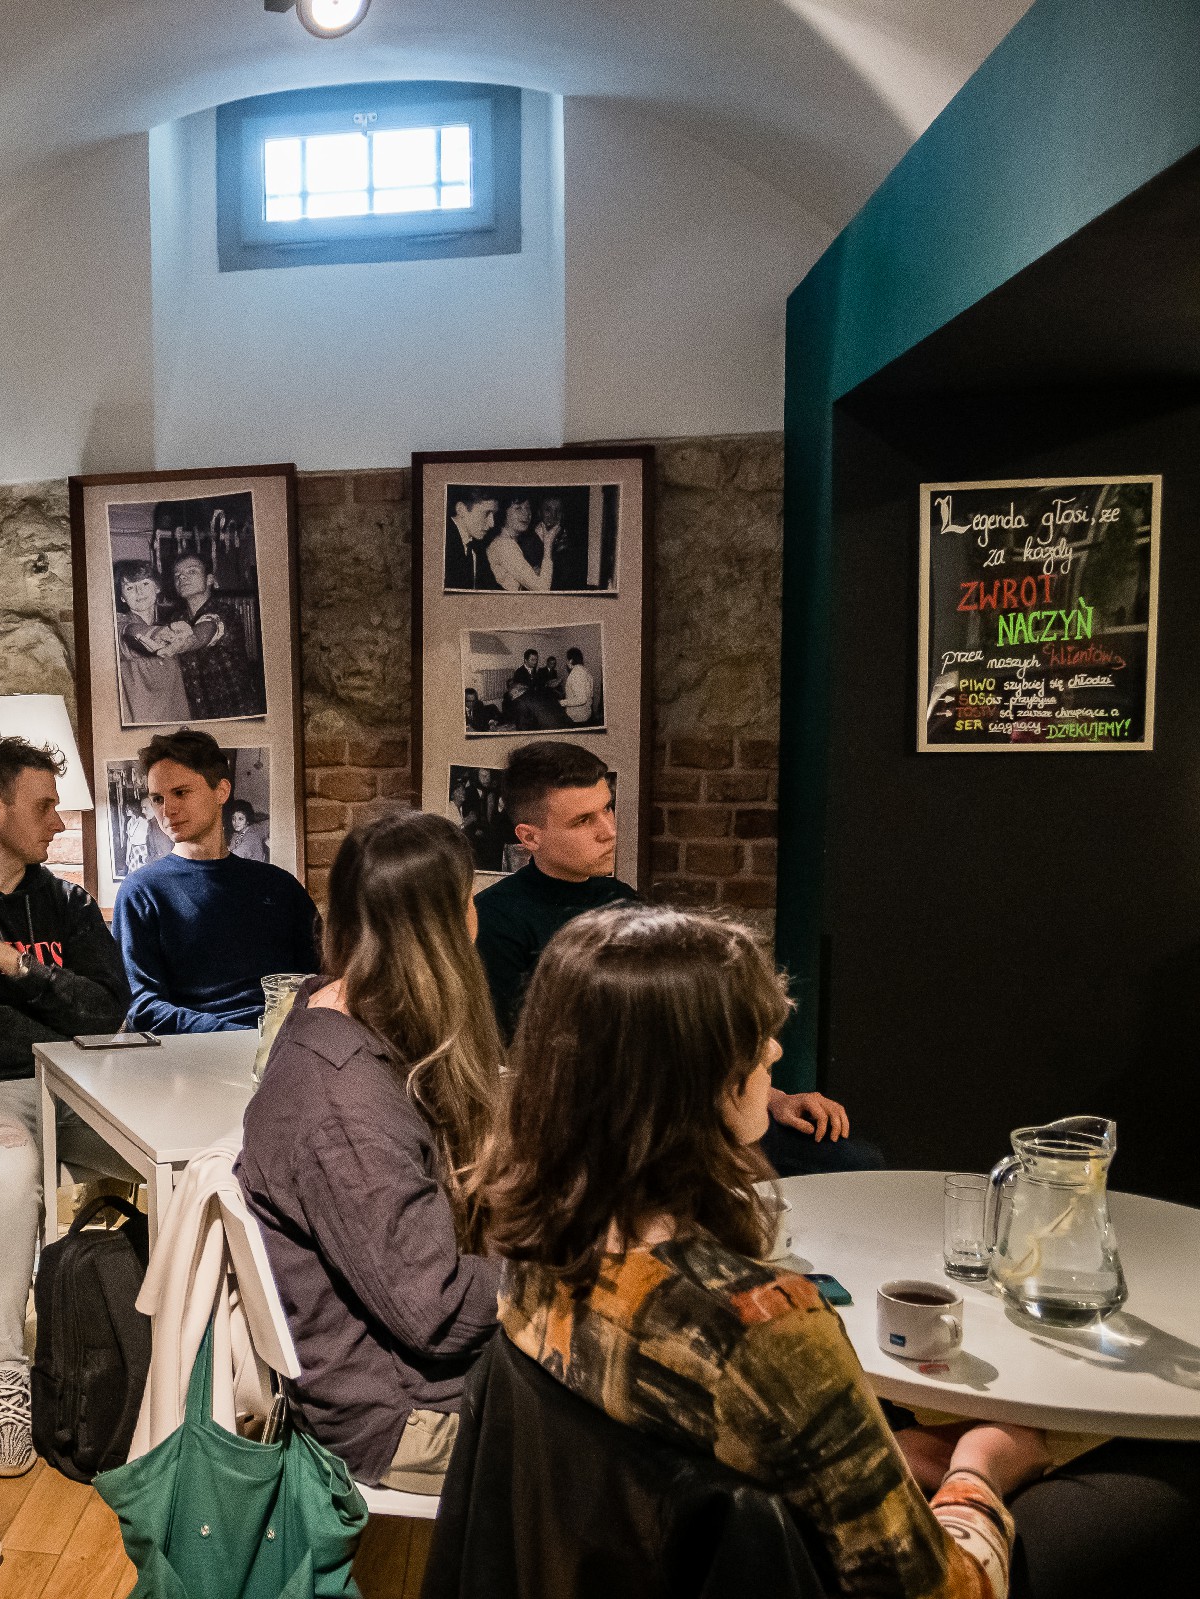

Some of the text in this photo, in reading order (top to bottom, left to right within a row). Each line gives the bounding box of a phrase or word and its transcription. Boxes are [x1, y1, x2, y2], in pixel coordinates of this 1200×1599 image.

[934, 495, 1028, 547] Legenda
[983, 549, 1006, 567] za
[956, 574, 1057, 611] ZWROT
[996, 596, 1095, 647] NACZYŃ
[941, 650, 985, 675] przez
[987, 654, 1042, 679] naszych
[959, 677, 996, 692] PIWO
[1003, 676, 1045, 697] szybciej
[954, 719, 984, 732] SER
